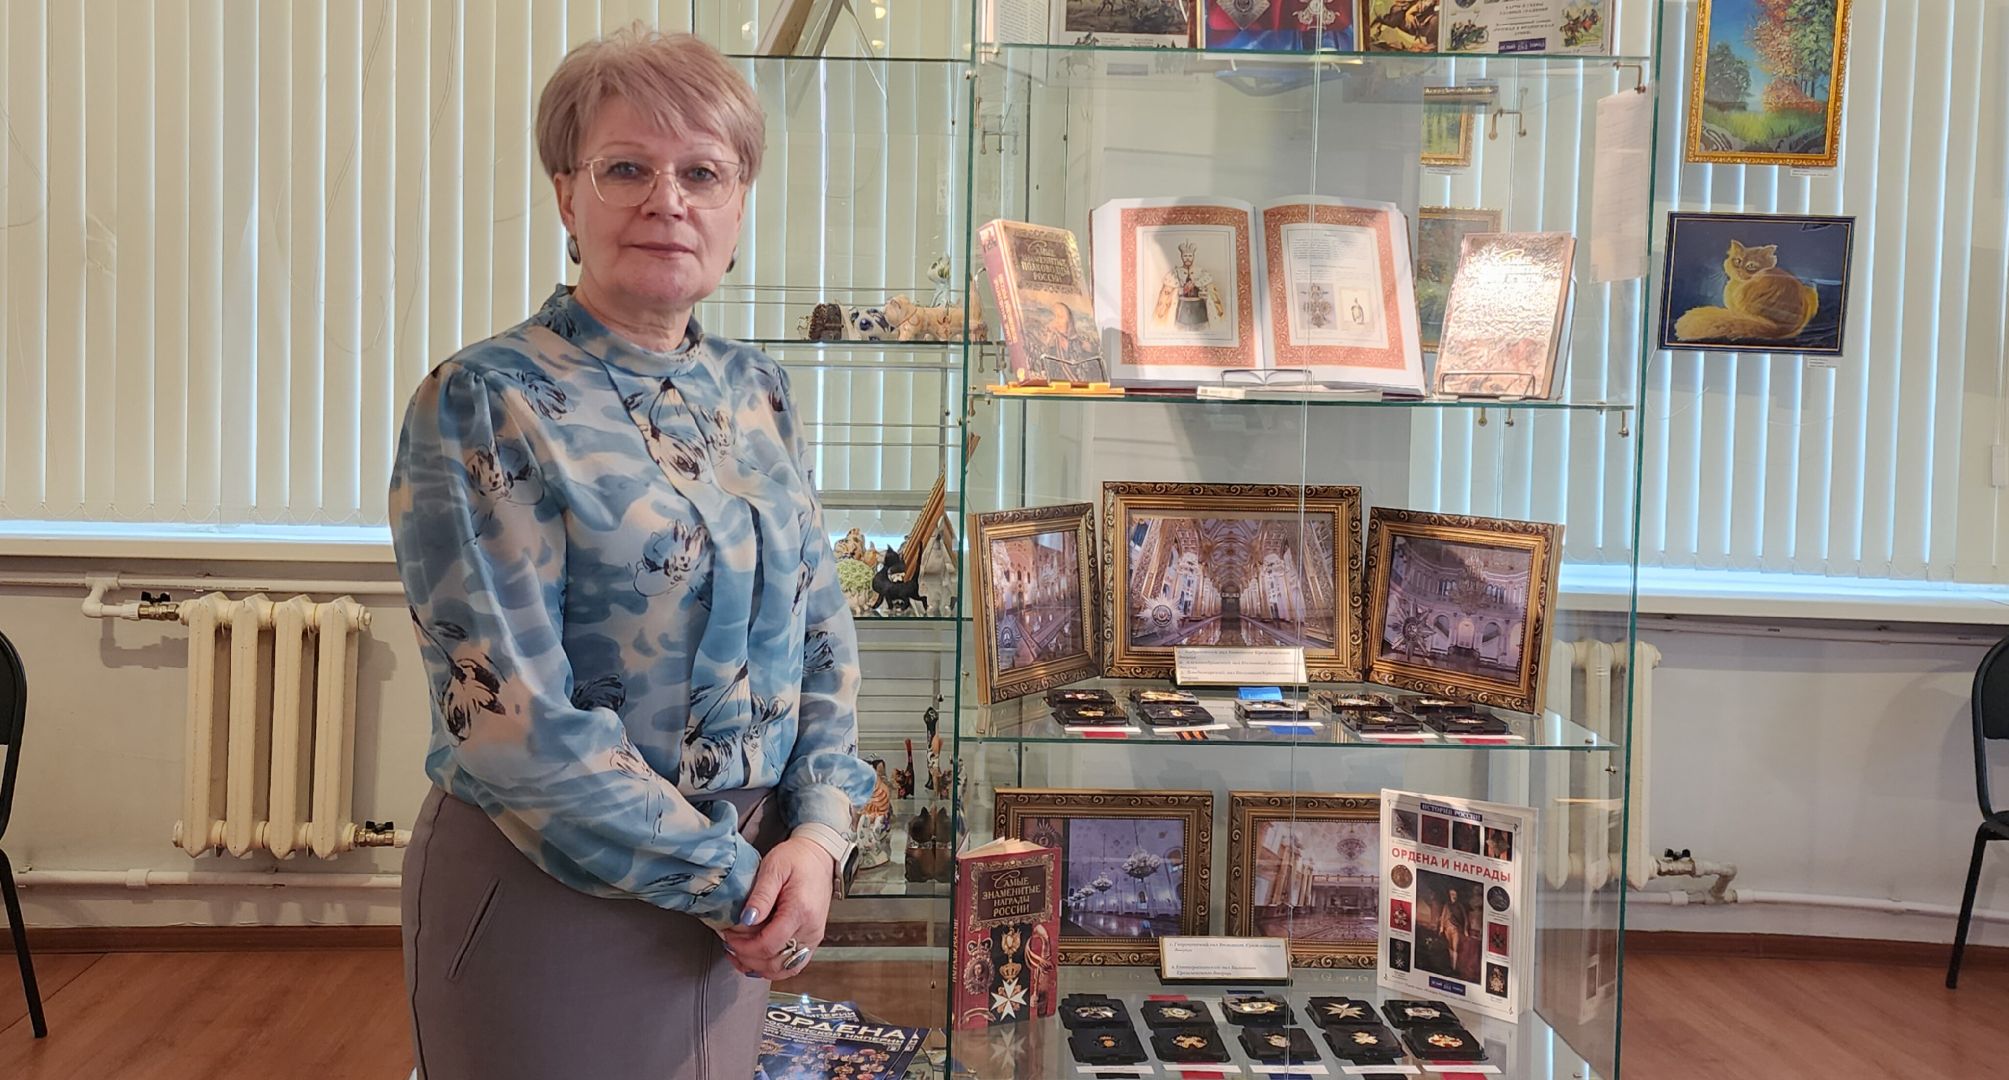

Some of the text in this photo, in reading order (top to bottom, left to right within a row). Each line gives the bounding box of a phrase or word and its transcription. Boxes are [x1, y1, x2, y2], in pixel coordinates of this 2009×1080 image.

[1454, 809, 1481, 820] РОССИИ
[1391, 847, 1512, 883] ОРДЕНА И НАГРАДЫ
[981, 885, 1041, 900] ЗНАМЕНИТЫЕ
[993, 895, 1030, 907] НАГРАДЫ
[993, 904, 1030, 918] РОССИИ
[767, 1010, 906, 1040] ОРДЕНА
[845, 1033, 905, 1044] ИМПЕРИИ
